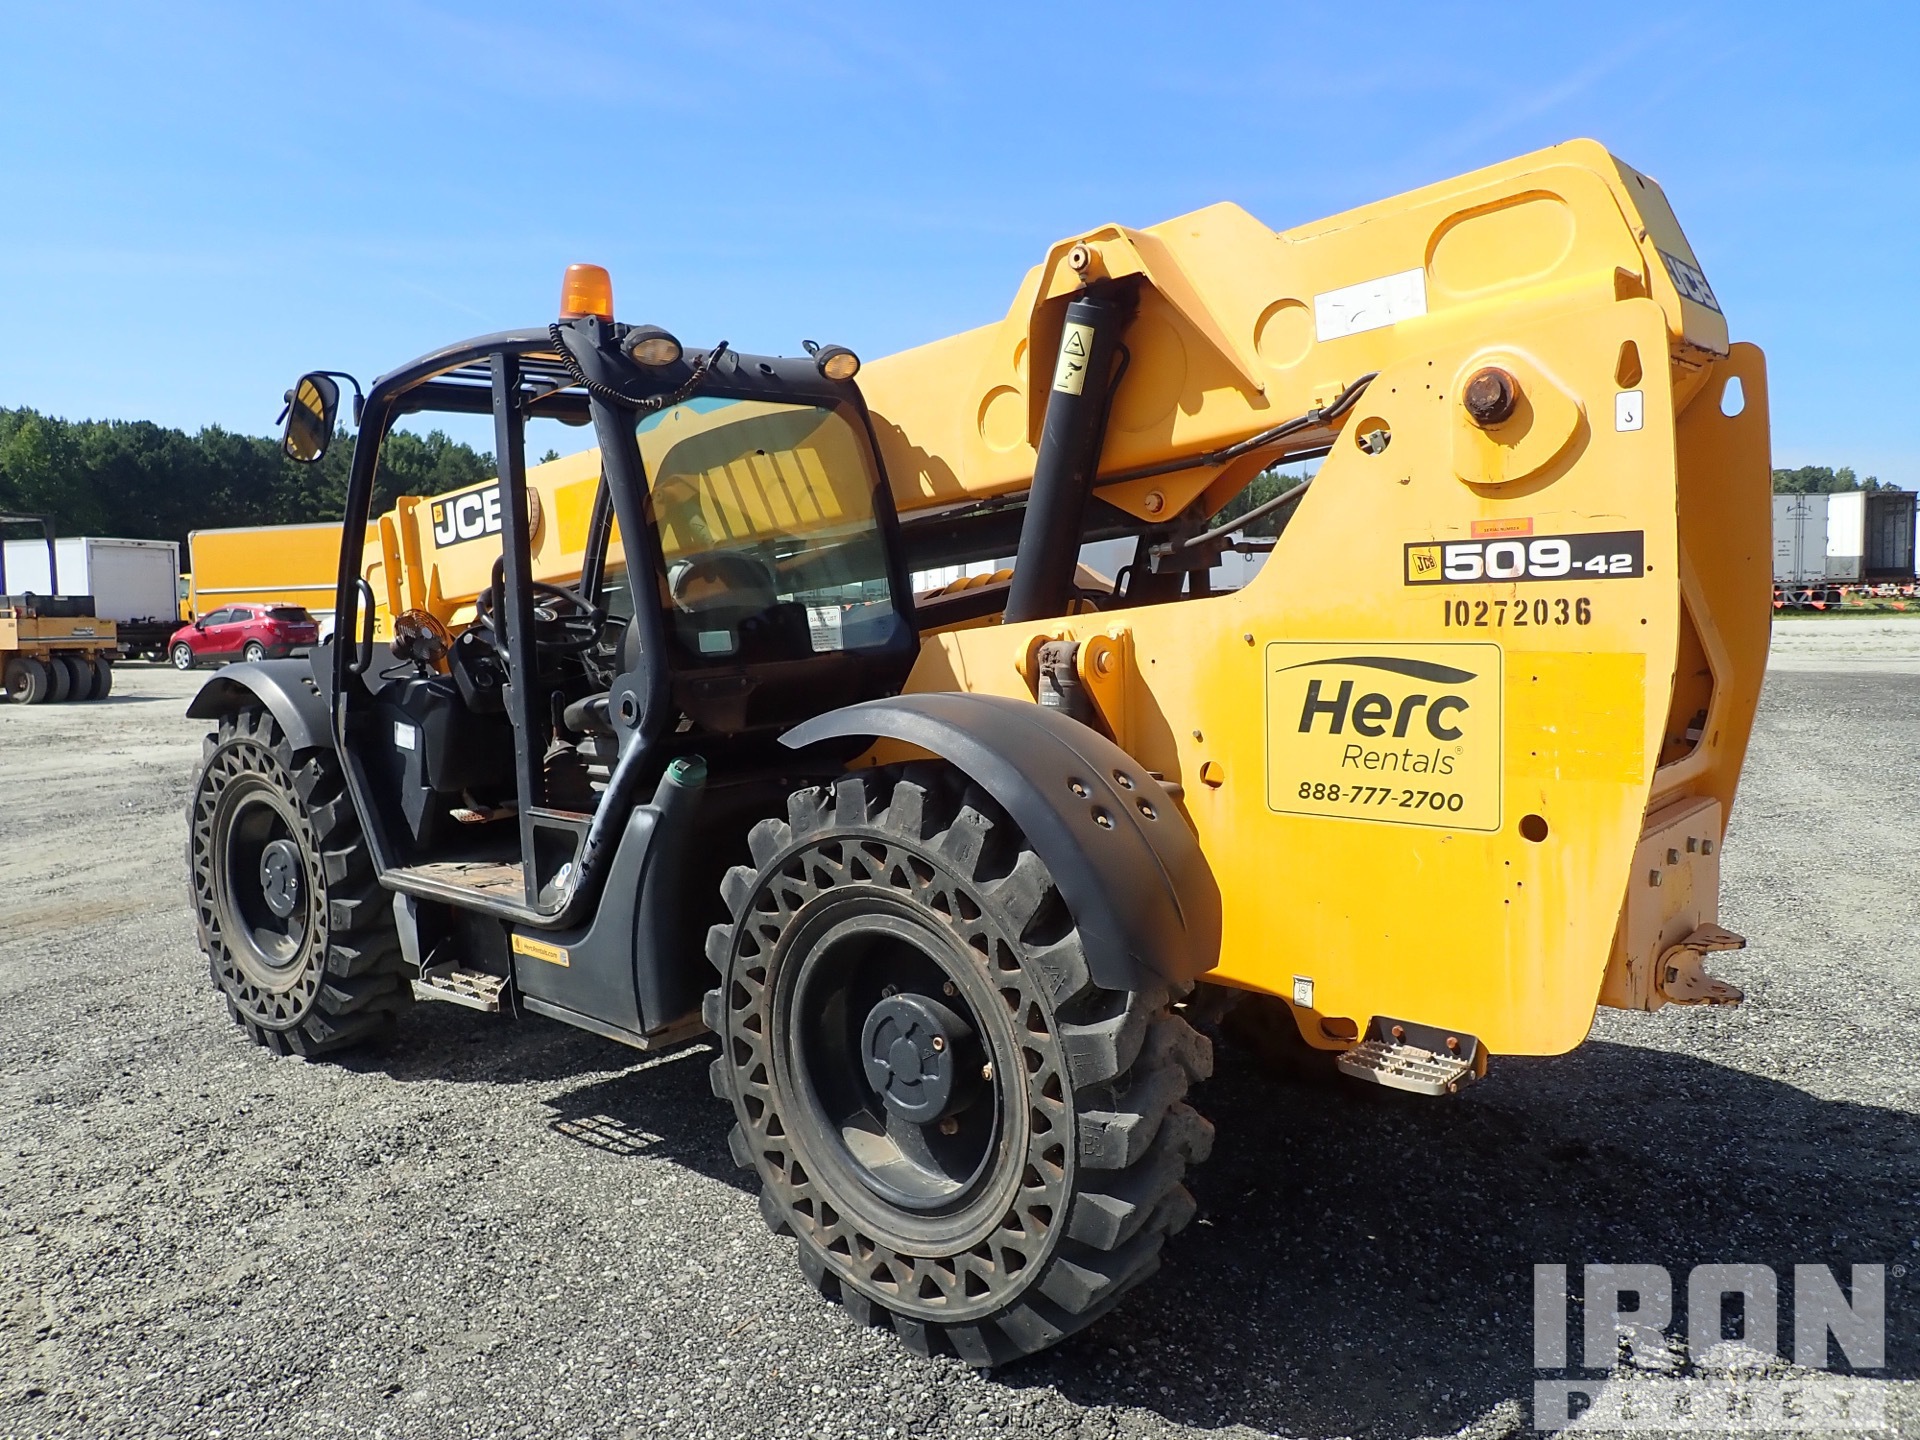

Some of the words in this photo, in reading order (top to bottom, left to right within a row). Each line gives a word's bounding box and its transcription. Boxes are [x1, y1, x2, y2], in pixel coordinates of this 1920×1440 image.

[1667, 256, 1719, 310] JCB
[1417, 556, 1436, 571] JCB
[1444, 539, 1633, 580] 509-42
[1444, 597, 1592, 627] 10272036
[1298, 679, 1470, 741] Herc
[1341, 744, 1455, 775] Rentals
[1298, 782, 1464, 812] 888-777-2700
